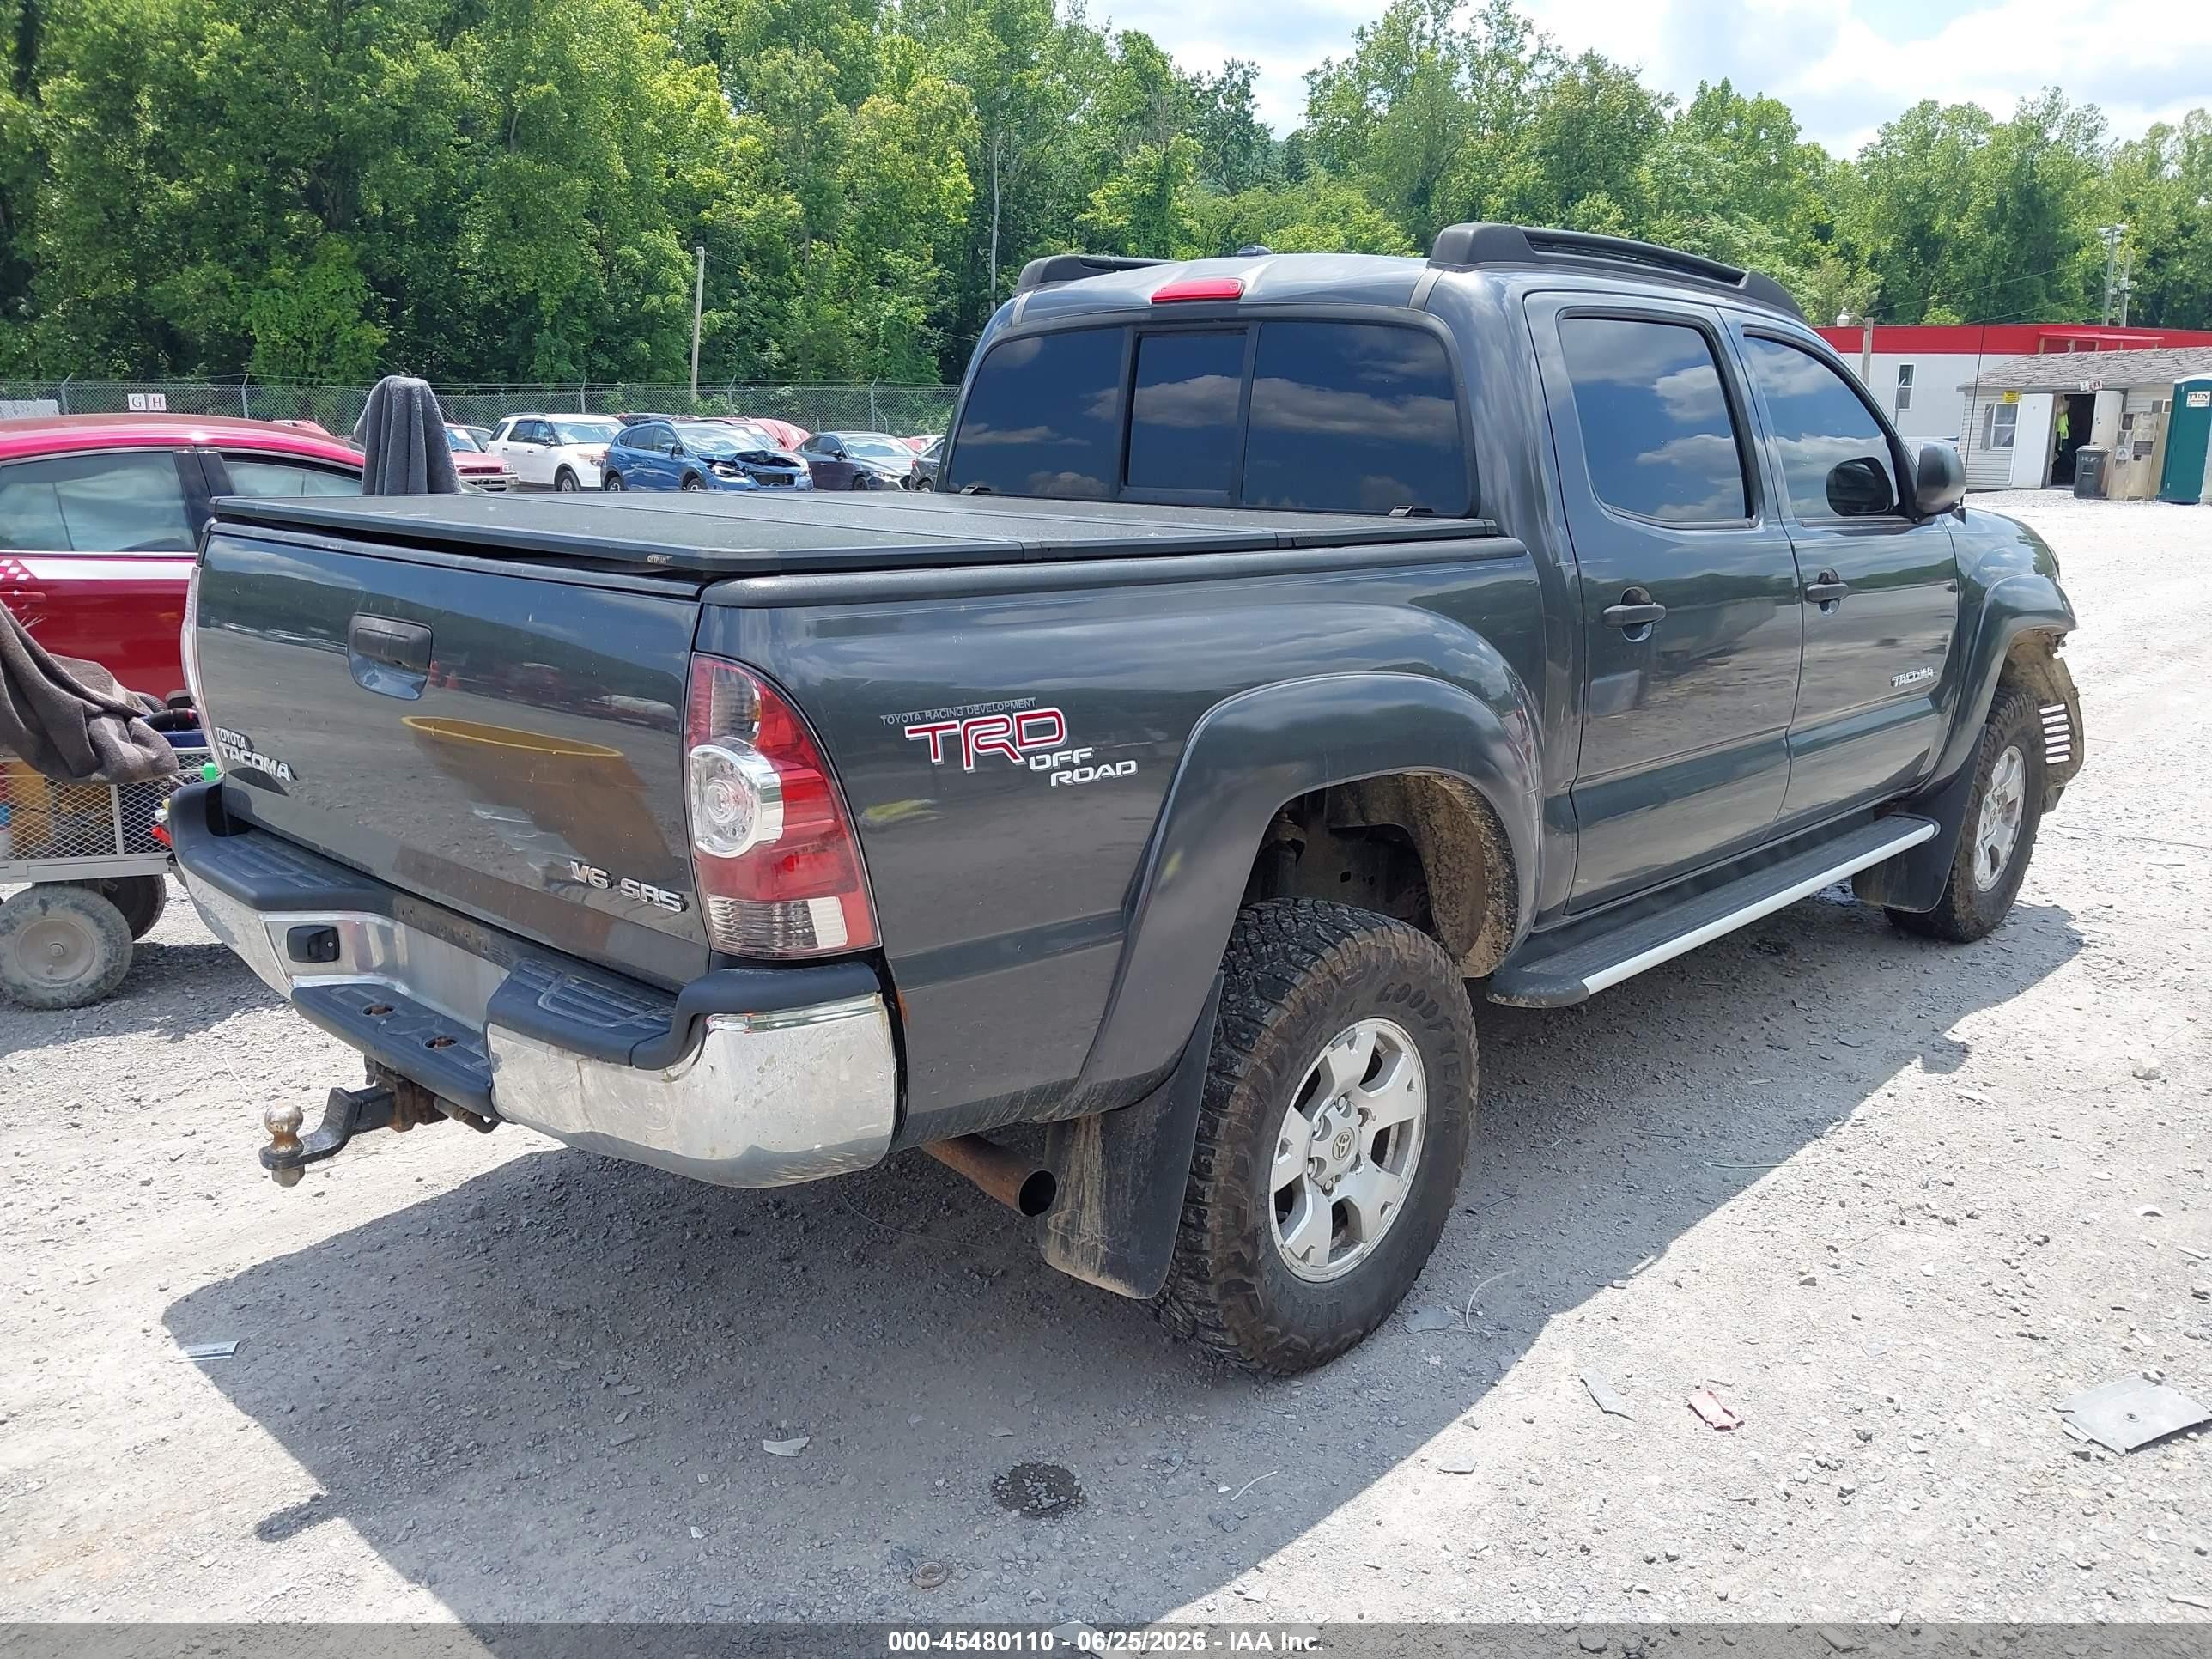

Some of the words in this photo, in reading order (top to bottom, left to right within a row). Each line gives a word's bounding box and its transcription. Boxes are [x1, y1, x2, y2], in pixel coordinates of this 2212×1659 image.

[131, 397, 142, 408] G
[152, 397, 163, 408] H
[1891, 666, 1934, 688] TACOMA
[880, 712, 921, 726] TOYOTA
[925, 706, 963, 720] RACING
[966, 697, 1036, 715] DEVELOPMENT
[215, 726, 247, 750] TOYOTA
[904, 707, 1066, 772] TRD
[218, 741, 292, 782] TACOMA
[1029, 747, 1093, 771] OFF
[1050, 759, 1137, 787] ROAD
[570, 860, 611, 889] V6
[620, 877, 685, 913] SR5
